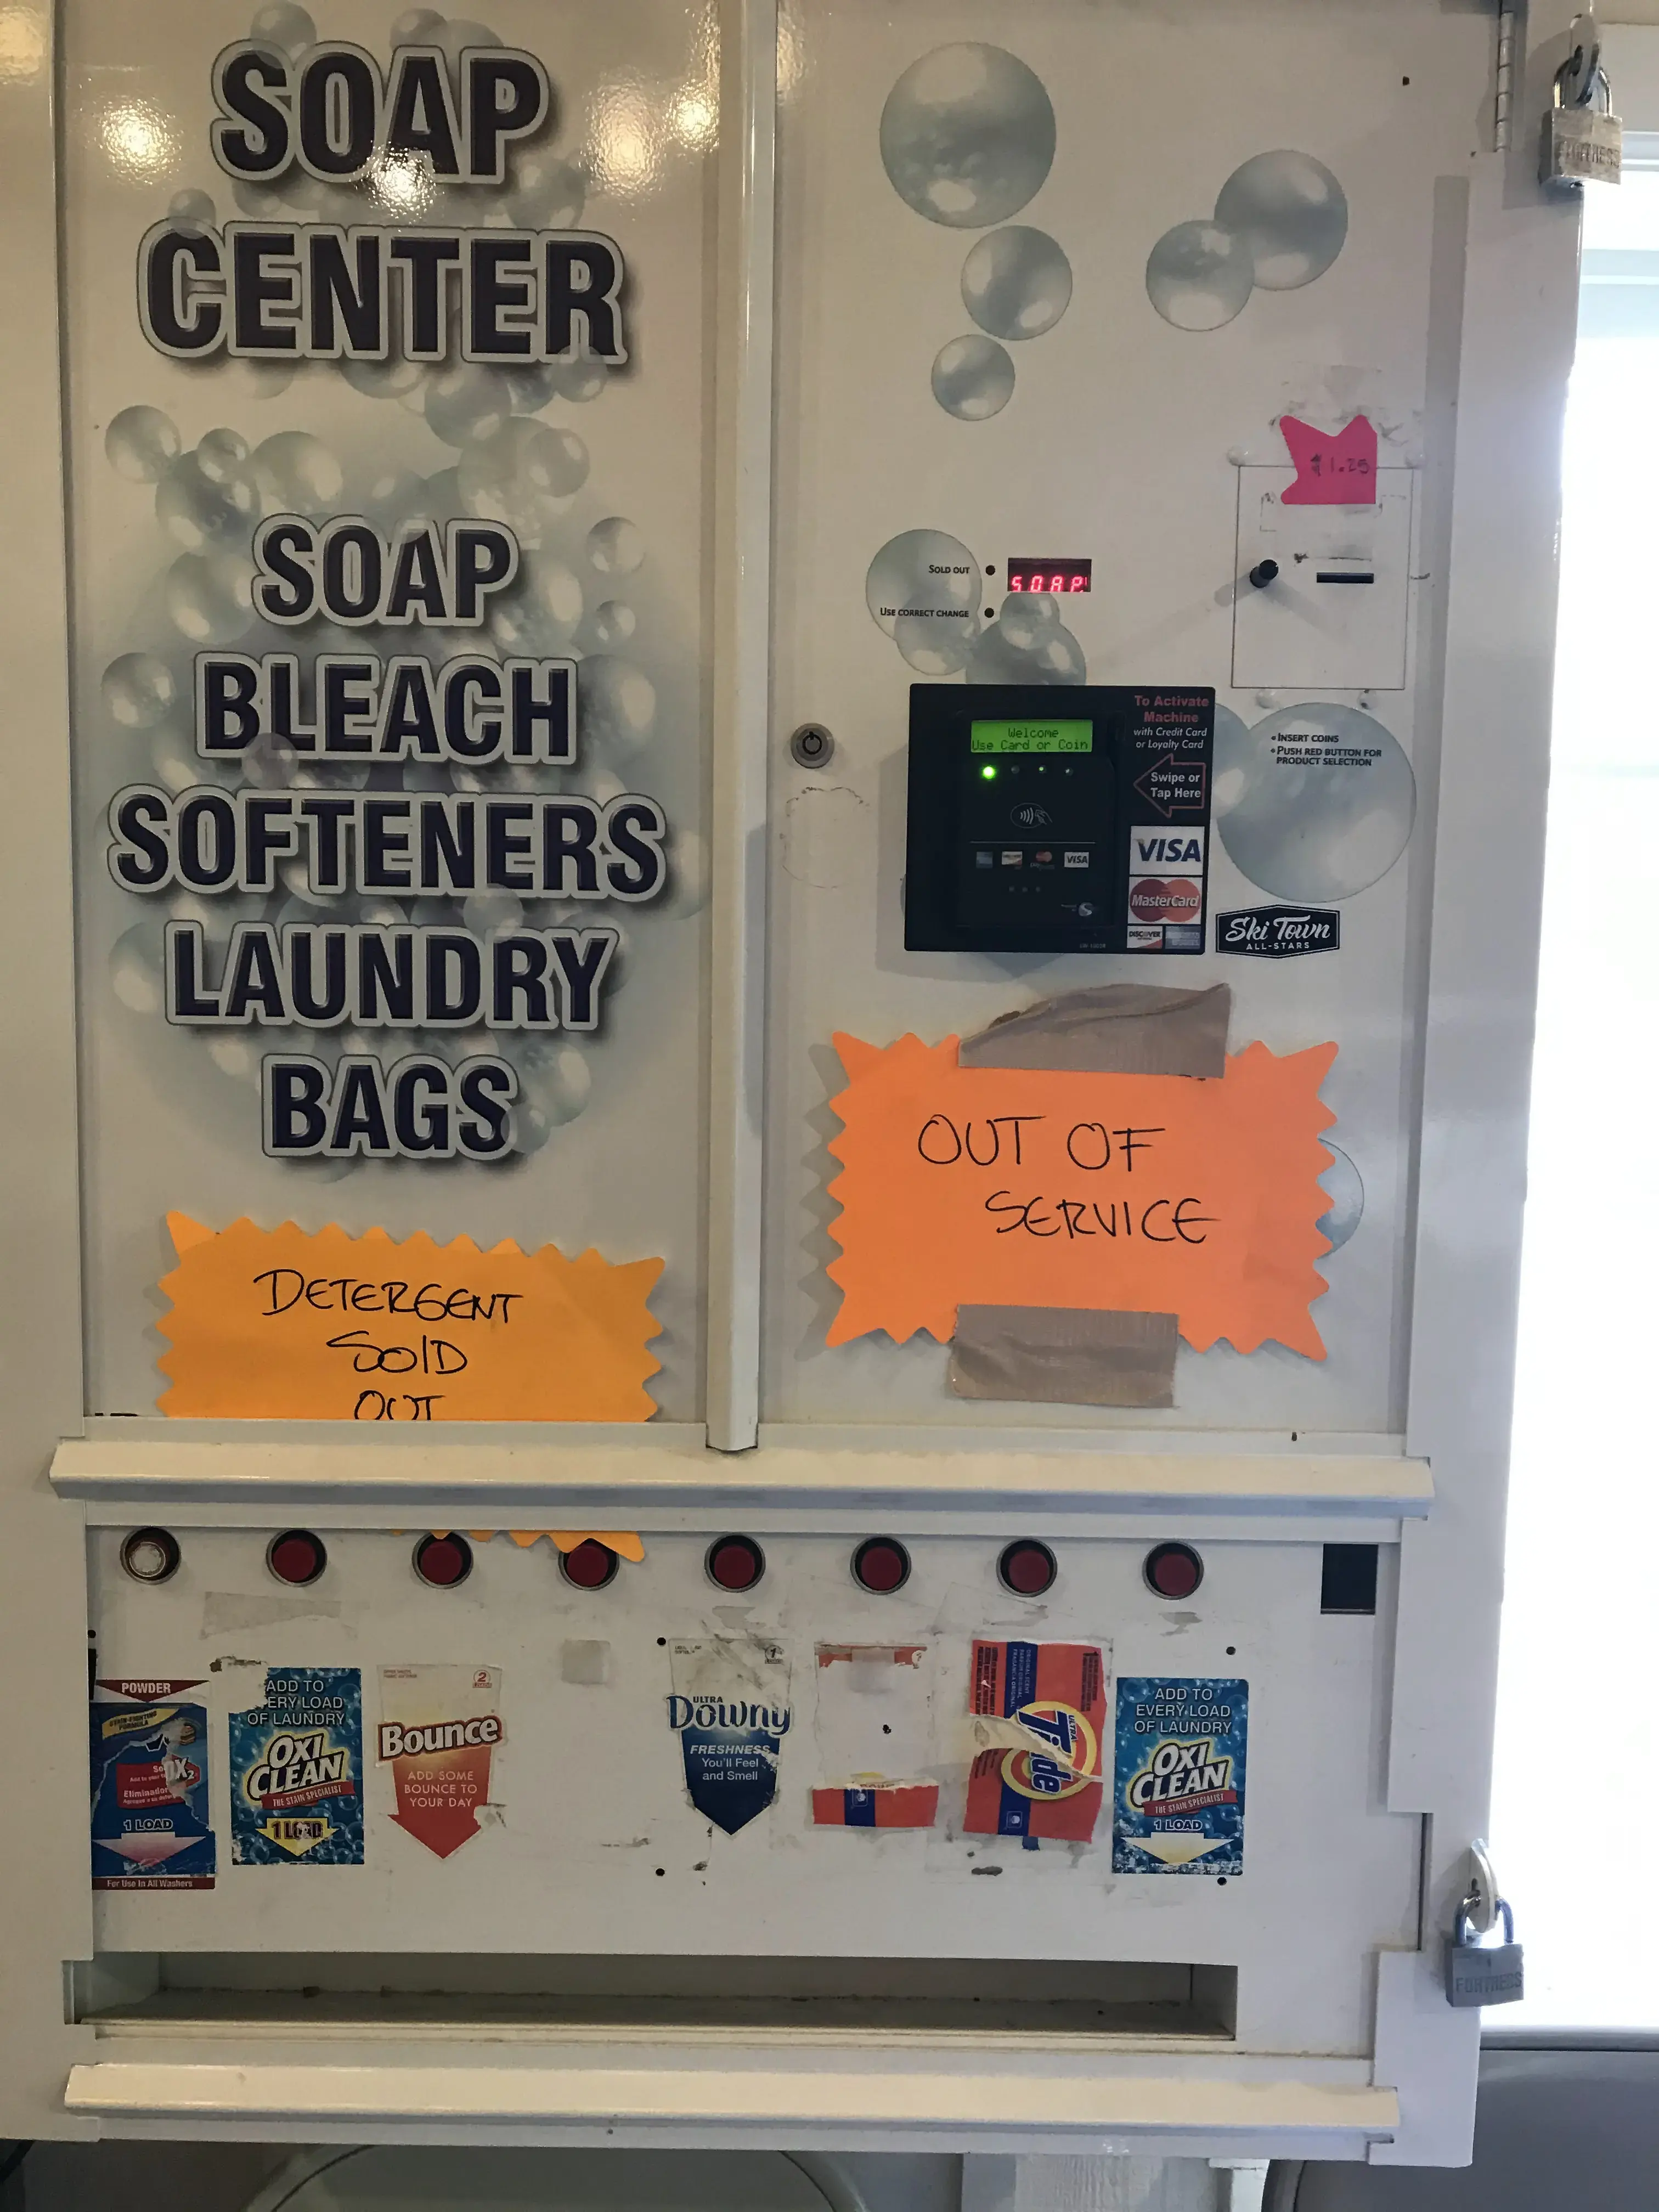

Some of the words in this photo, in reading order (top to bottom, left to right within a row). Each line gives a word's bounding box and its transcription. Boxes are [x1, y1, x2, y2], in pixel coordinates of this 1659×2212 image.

[217, 47, 544, 179] SOAP
[144, 227, 621, 358] CENTER
[258, 521, 512, 620] SOAP
[929, 565, 951, 574] SOLD
[880, 607, 896, 617] USE
[898, 609, 934, 617] CORRECT
[1135, 696, 1150, 707] To
[1154, 696, 1209, 707] Activate
[200, 658, 572, 759] BLEACH
[1143, 712, 1199, 723] Machine
[1008, 727, 1059, 738] Welcome
[1133, 727, 1154, 737] with
[1155, 727, 1184, 737] Credit
[1185, 727, 1207, 737] Card
[1278, 732, 1309, 742] INSERT
[1311, 734, 1339, 743] COINS
[971, 740, 994, 751] Use
[1000, 740, 1030, 751] Card
[1037, 742, 1051, 751] or
[1058, 740, 1088, 751] Coin
[1136, 741, 1146, 749] or
[1147, 739, 1179, 750] Loyalty
[1181, 740, 1204, 749] Card
[1277, 746, 1302, 755] PUSH
[1305, 748, 1322, 756] RED
[1324, 748, 1361, 757] BUTTON
[1364, 749, 1382, 757] FOR
[1276, 757, 1321, 765] PRODUCT
[1323, 758, 1372, 766] SELECTION
[1150, 771, 1186, 785] Swipe
[1188, 773, 1200, 783] or
[1150, 787, 1172, 799] Tap
[1174, 788, 1201, 798] Here
[114, 791, 660, 896] SOFTENERS
[1138, 838, 1202, 862] VISA
[1066, 855, 1089, 865] VISA
[1131, 894, 1199, 908] MasterCard
[1225, 916, 1270, 942] Ski
[1273, 915, 1331, 940] Town
[1246, 941, 1310, 950] ALL-STARS
[172, 927, 613, 1024] LAUNDRY
[269, 1060, 513, 1154] BAGS
[917, 1113, 1046, 1166] OUT
[1066, 1122, 1166, 1172] OF
[985, 1189, 1221, 1245] SERVICE
[252, 1267, 524, 1324] DETERGENT
[769, 1647, 778, 1658] 1
[478, 1672, 487, 1683] 2
[121, 1682, 171, 1694] POWDER
[266, 1680, 298, 1692] ADD
[303, 1680, 324, 1692] TO
[1154, 1688, 1187, 1700] ADD
[1192, 1688, 1212, 1701] TO
[268, 1696, 297, 1709] ERY
[302, 1696, 343, 1709] LOAD
[666, 1695, 791, 1736] Downy
[1136, 1705, 1186, 1717] EVERY
[1189, 1705, 1231, 1717] LOAD
[247, 1713, 268, 1725] OF
[273, 1713, 345, 1725] LAUNDRY
[1066, 1714, 1078, 1742] ULTRA
[1134, 1720, 1155, 1733] OF
[1160, 1721, 1232, 1734] LAUNDRY
[381, 1717, 499, 1757] Bounce
[269, 1735, 323, 1769] OXI
[690, 1745, 770, 1755] FRESHNESS
[702, 1758, 732, 1768] You'll
[735, 1758, 759, 1768] Feel
[1154, 1743, 1207, 1777] OXI
[249, 1754, 344, 1800] CLEAN
[408, 1771, 433, 1781] ADD
[438, 1771, 474, 1781] SOME
[702, 1770, 724, 1781] and
[726, 1771, 758, 1781] Smell
[404, 1784, 456, 1794] BOUNCE
[461, 1785, 477, 1794] TO
[1133, 1762, 1227, 1807] CLEAN
[123, 1787, 168, 1798] Eliminador
[273, 1798, 285, 1807] THE
[286, 1793, 305, 1806] STAIN
[306, 1785, 342, 1801] SPECIALIST
[410, 1798, 443, 1807] YOUR
[449, 1797, 472, 1807] DAY
[1155, 1805, 1166, 1814] THE
[1168, 1801, 1188, 1814] STAIN
[1188, 1793, 1224, 1810] SPECIALIST
[123, 1819, 131, 1831] 1
[135, 1818, 173, 1831] LOAD
[272, 1821, 281, 1839] 1
[1154, 1820, 1161, 1830] 1
[1165, 1819, 1203, 1831] LOAD
[107, 1879, 121, 1887] For
[122, 1879, 136, 1887] Use
[138, 1879, 146, 1887] In
[147, 1879, 158, 1887] All
[159, 1880, 193, 1888] Washers
